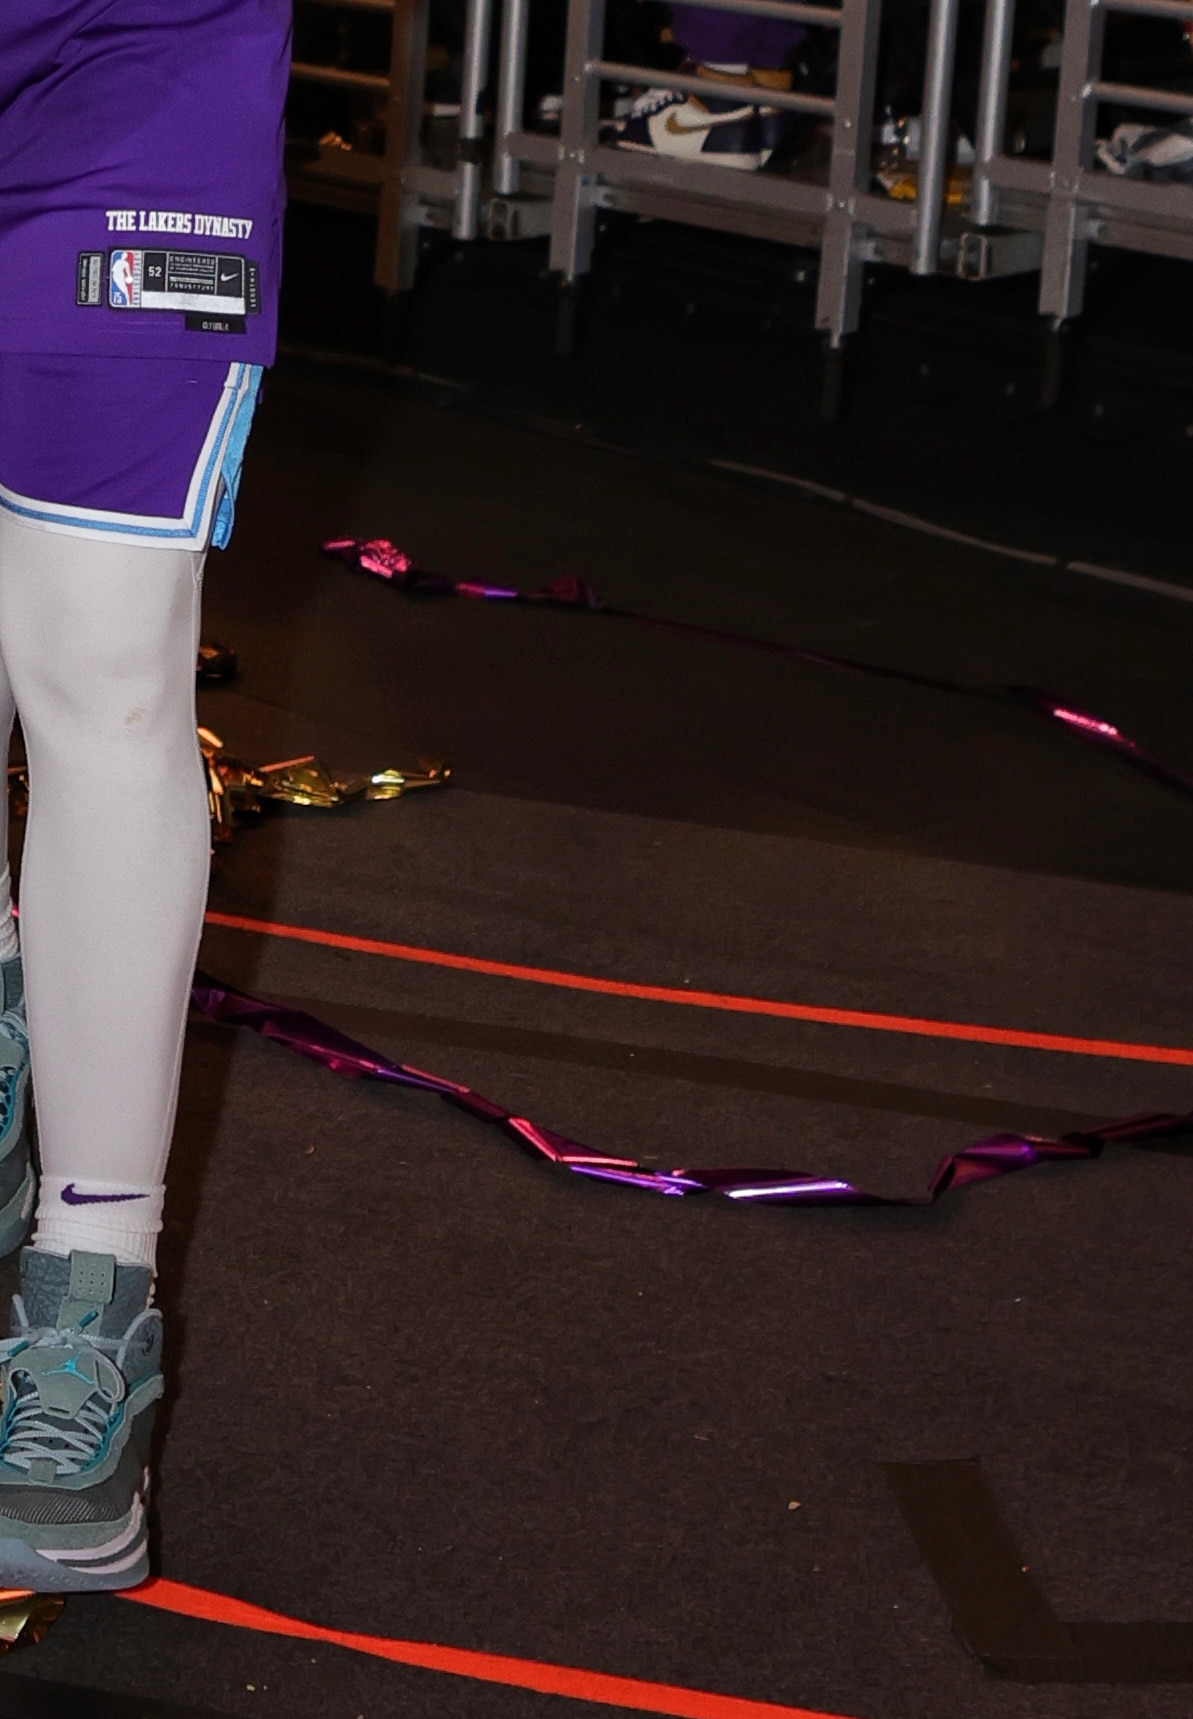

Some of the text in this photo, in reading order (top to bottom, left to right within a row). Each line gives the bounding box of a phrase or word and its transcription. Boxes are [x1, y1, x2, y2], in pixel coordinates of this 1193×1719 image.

[106, 210, 253, 239] THE LAKERS DYNASTY
[148, 266, 162, 278] 52
